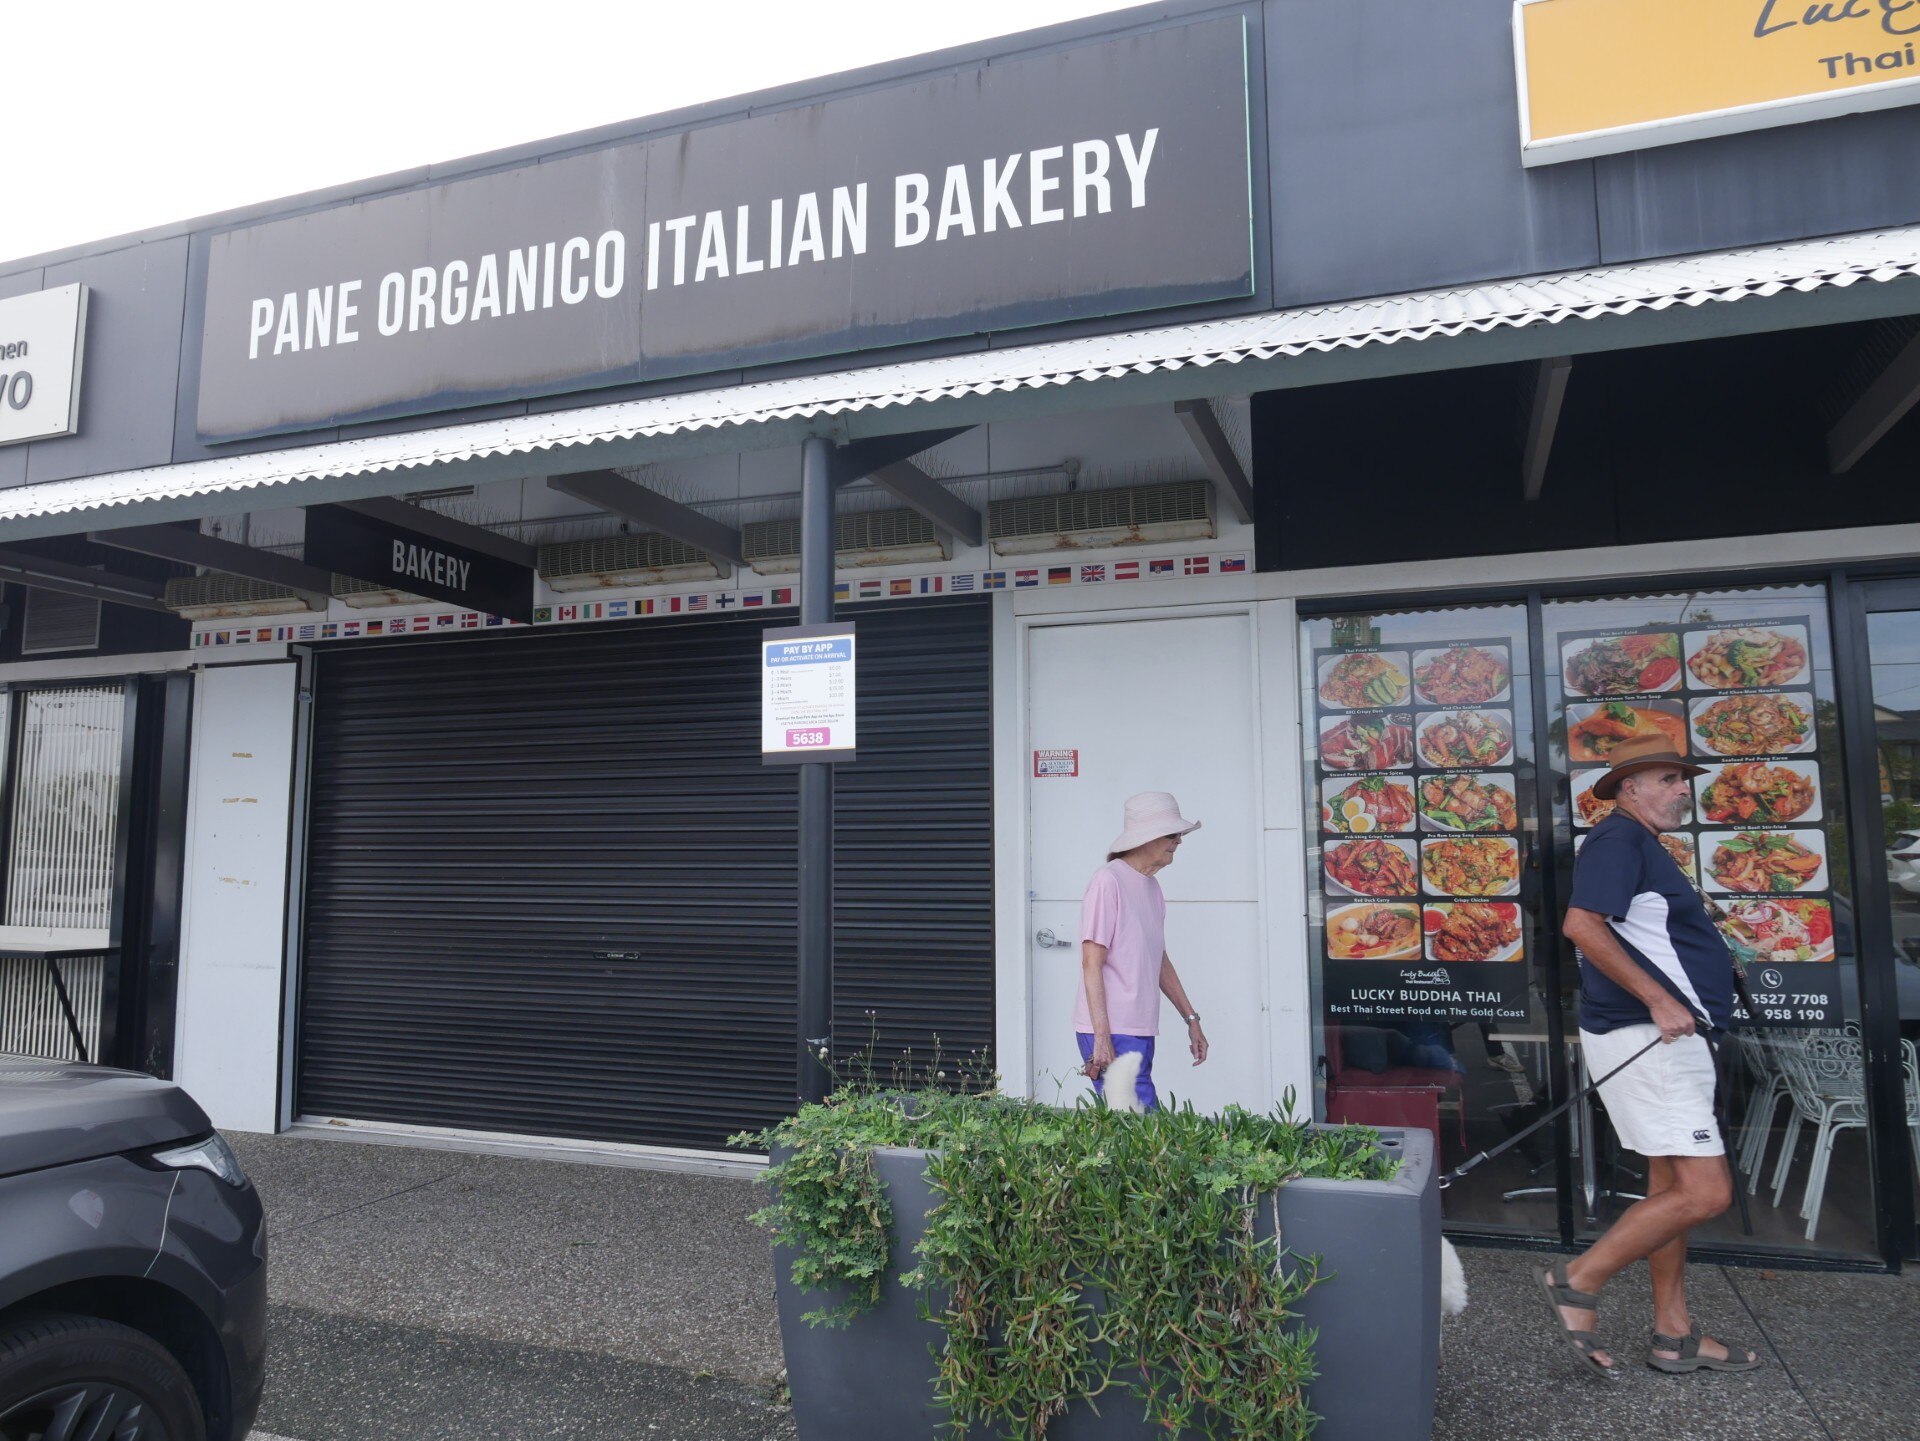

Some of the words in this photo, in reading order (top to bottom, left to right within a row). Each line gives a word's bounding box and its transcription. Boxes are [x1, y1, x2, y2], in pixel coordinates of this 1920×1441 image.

[1818, 42, 1915, 78] Thai
[249, 280, 362, 360] PANE
[377, 230, 626, 337] ORGANICO
[647, 182, 867, 290] ITALIAN
[895, 127, 1159, 248] BAKERY
[392, 539, 471, 591] BAKERY
[784, 646, 800, 654] PAY
[802, 644, 814, 653] BY
[815, 643, 832, 652] APP
[792, 732, 823, 745] 5638
[1351, 989, 1394, 1000] LUCKY
[1400, 990, 1462, 1002] BUDDHA
[1466, 991, 1501, 1002] THAI
[1752, 994, 1786, 1004] 5527
[1792, 994, 1828, 1005] 7708
[1331, 1005, 1350, 1013] Best
[1353, 1005, 1373, 1013] Thai
[1376, 1006, 1404, 1014] Street
[1408, 1006, 1430, 1015] Food
[1450, 1007, 1468, 1016] The
[1470, 1008, 1493, 1016] Gold
[1496, 1009, 1524, 1017] Coast
[1764, 1009, 1792, 1020] 958
[1797, 1010, 1824, 1020] 190
